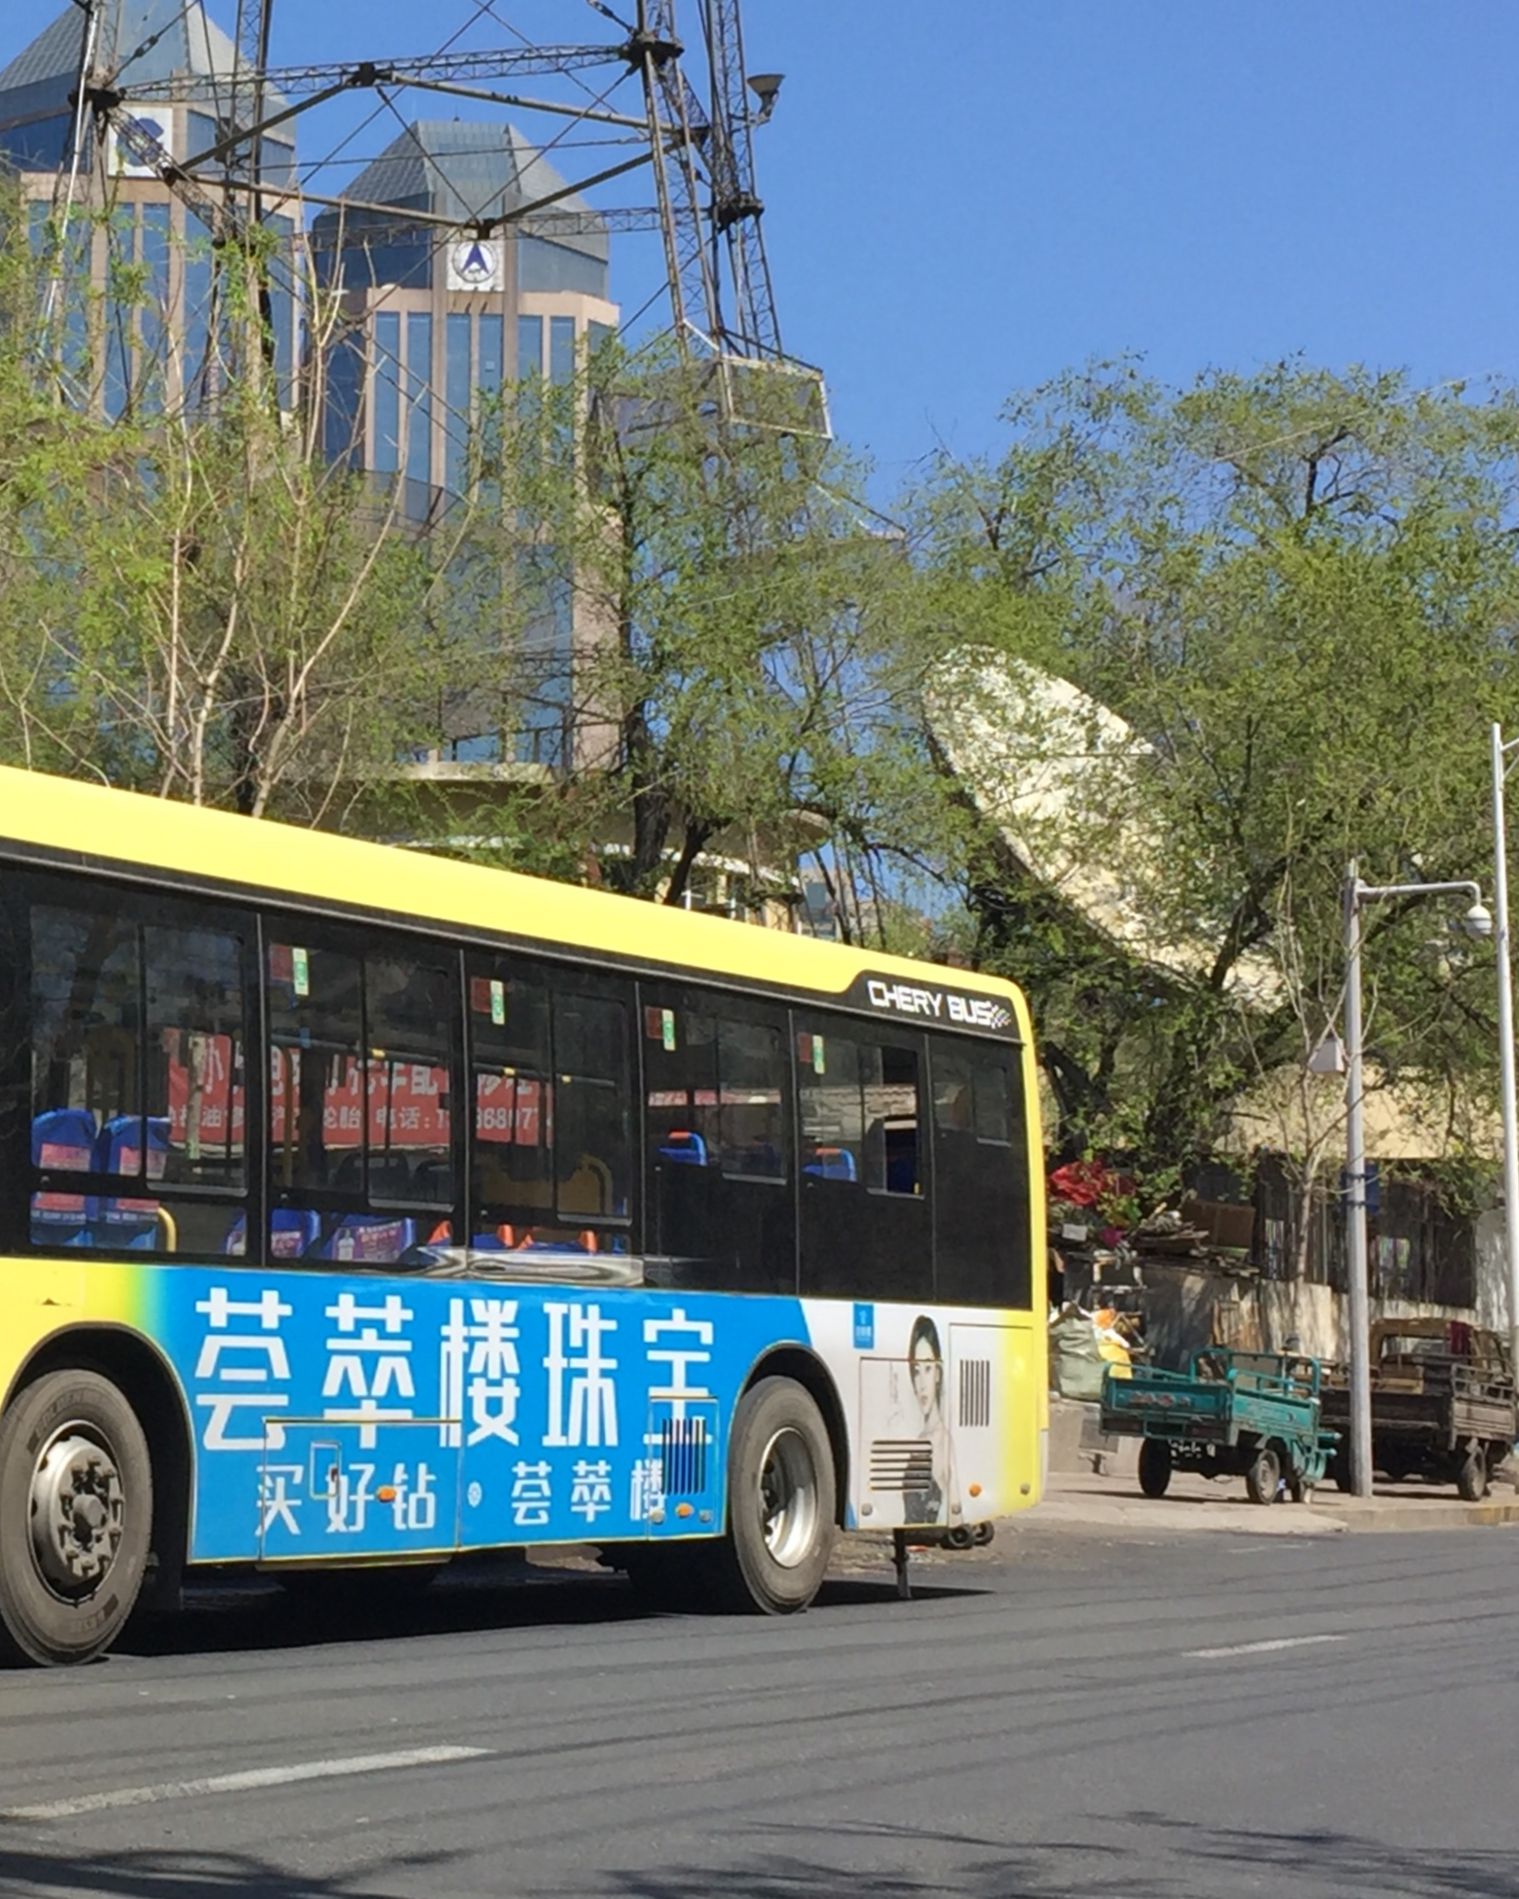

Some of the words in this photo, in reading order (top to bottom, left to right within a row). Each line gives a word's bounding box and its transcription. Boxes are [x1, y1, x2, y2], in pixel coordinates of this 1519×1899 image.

[867, 980, 942, 1018] CHERY
[946, 995, 994, 1027] BUS
[195, 1287, 714, 1450] 荟萃楼珠宝
[254, 1463, 436, 1537] 买好钻
[511, 1459, 668, 1526] 荟萃楼
